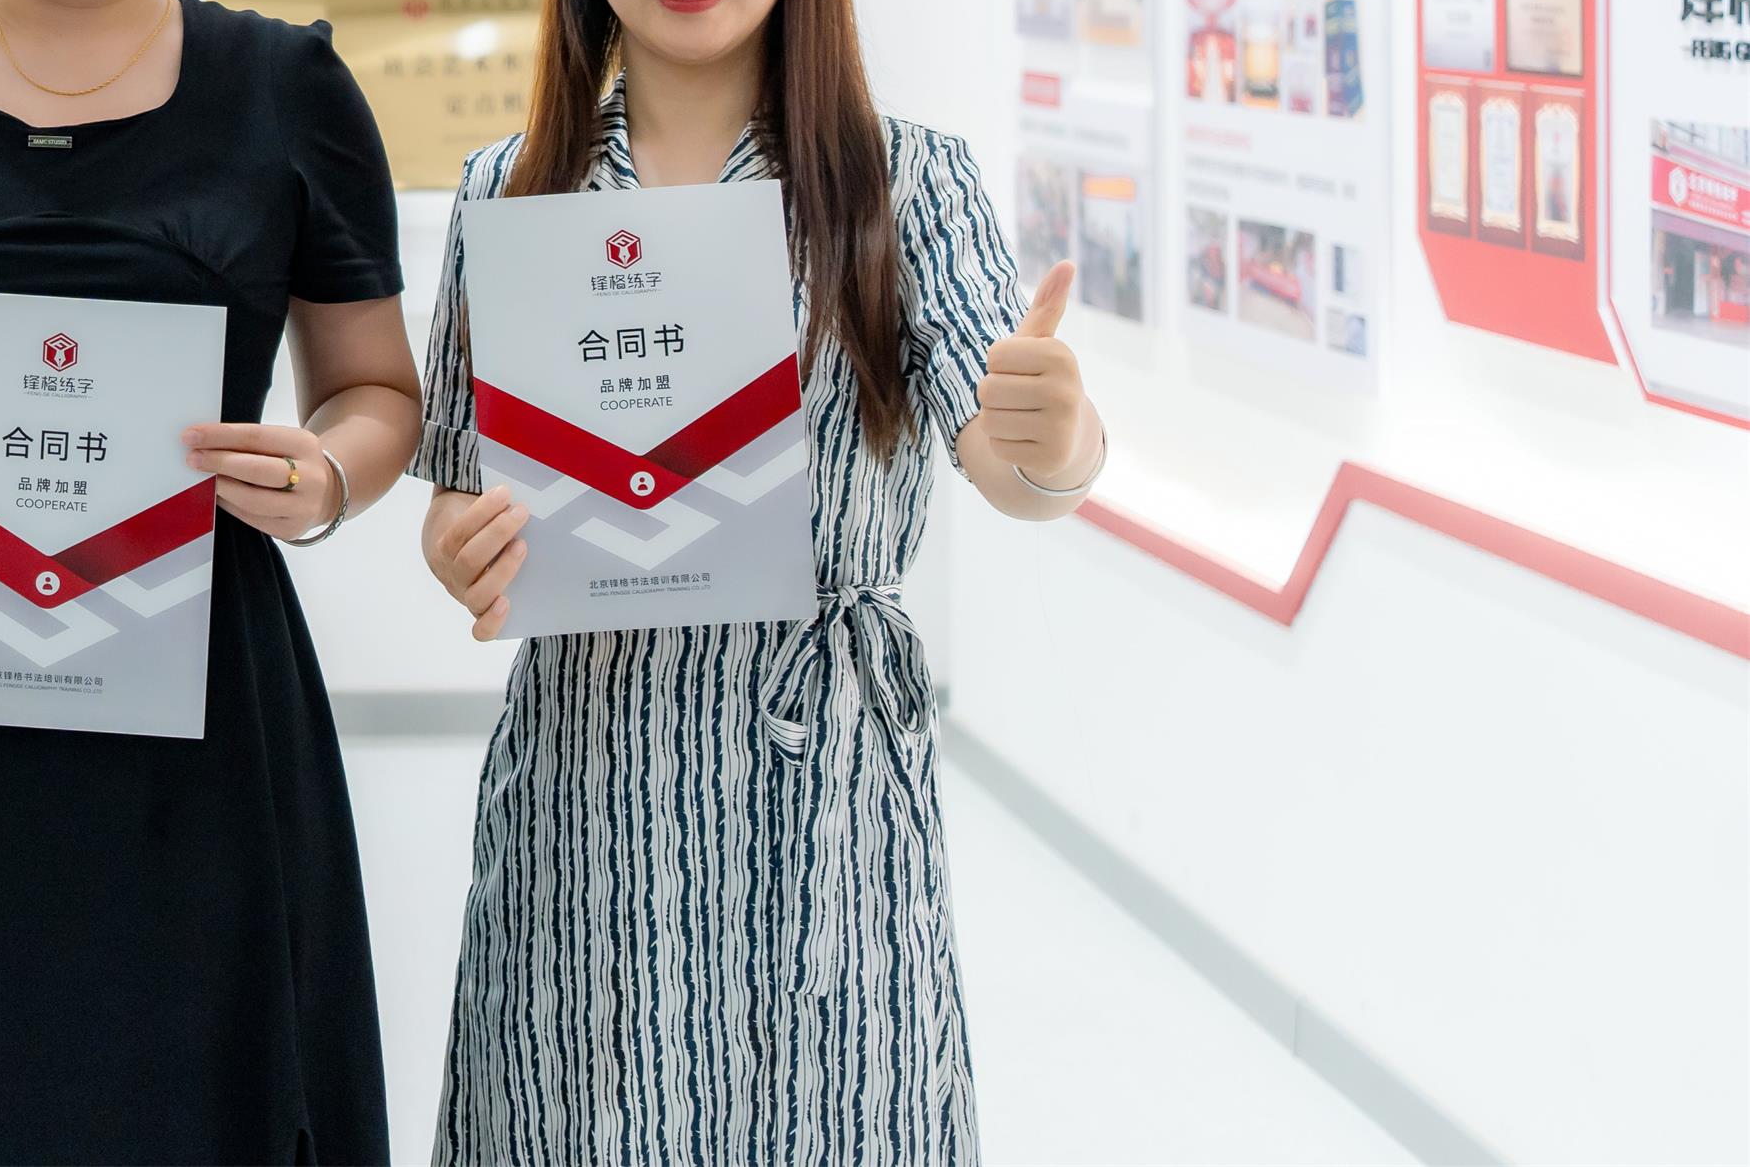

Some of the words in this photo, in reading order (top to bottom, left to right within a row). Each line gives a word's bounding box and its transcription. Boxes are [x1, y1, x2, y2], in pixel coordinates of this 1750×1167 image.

[590, 272, 662, 292] 锋格练字
[578, 323, 685, 363] 合同书
[23, 374, 94, 394] 锋格练字
[600, 374, 671, 393] 品牌加盟
[599, 396, 673, 411] COOPERATE
[2, 426, 108, 464] 合同书
[18, 477, 88, 495] 品牌加盟
[15, 498, 88, 513] COOPERATE
[589, 572, 711, 590] 北京锋格书法培训有限公司
